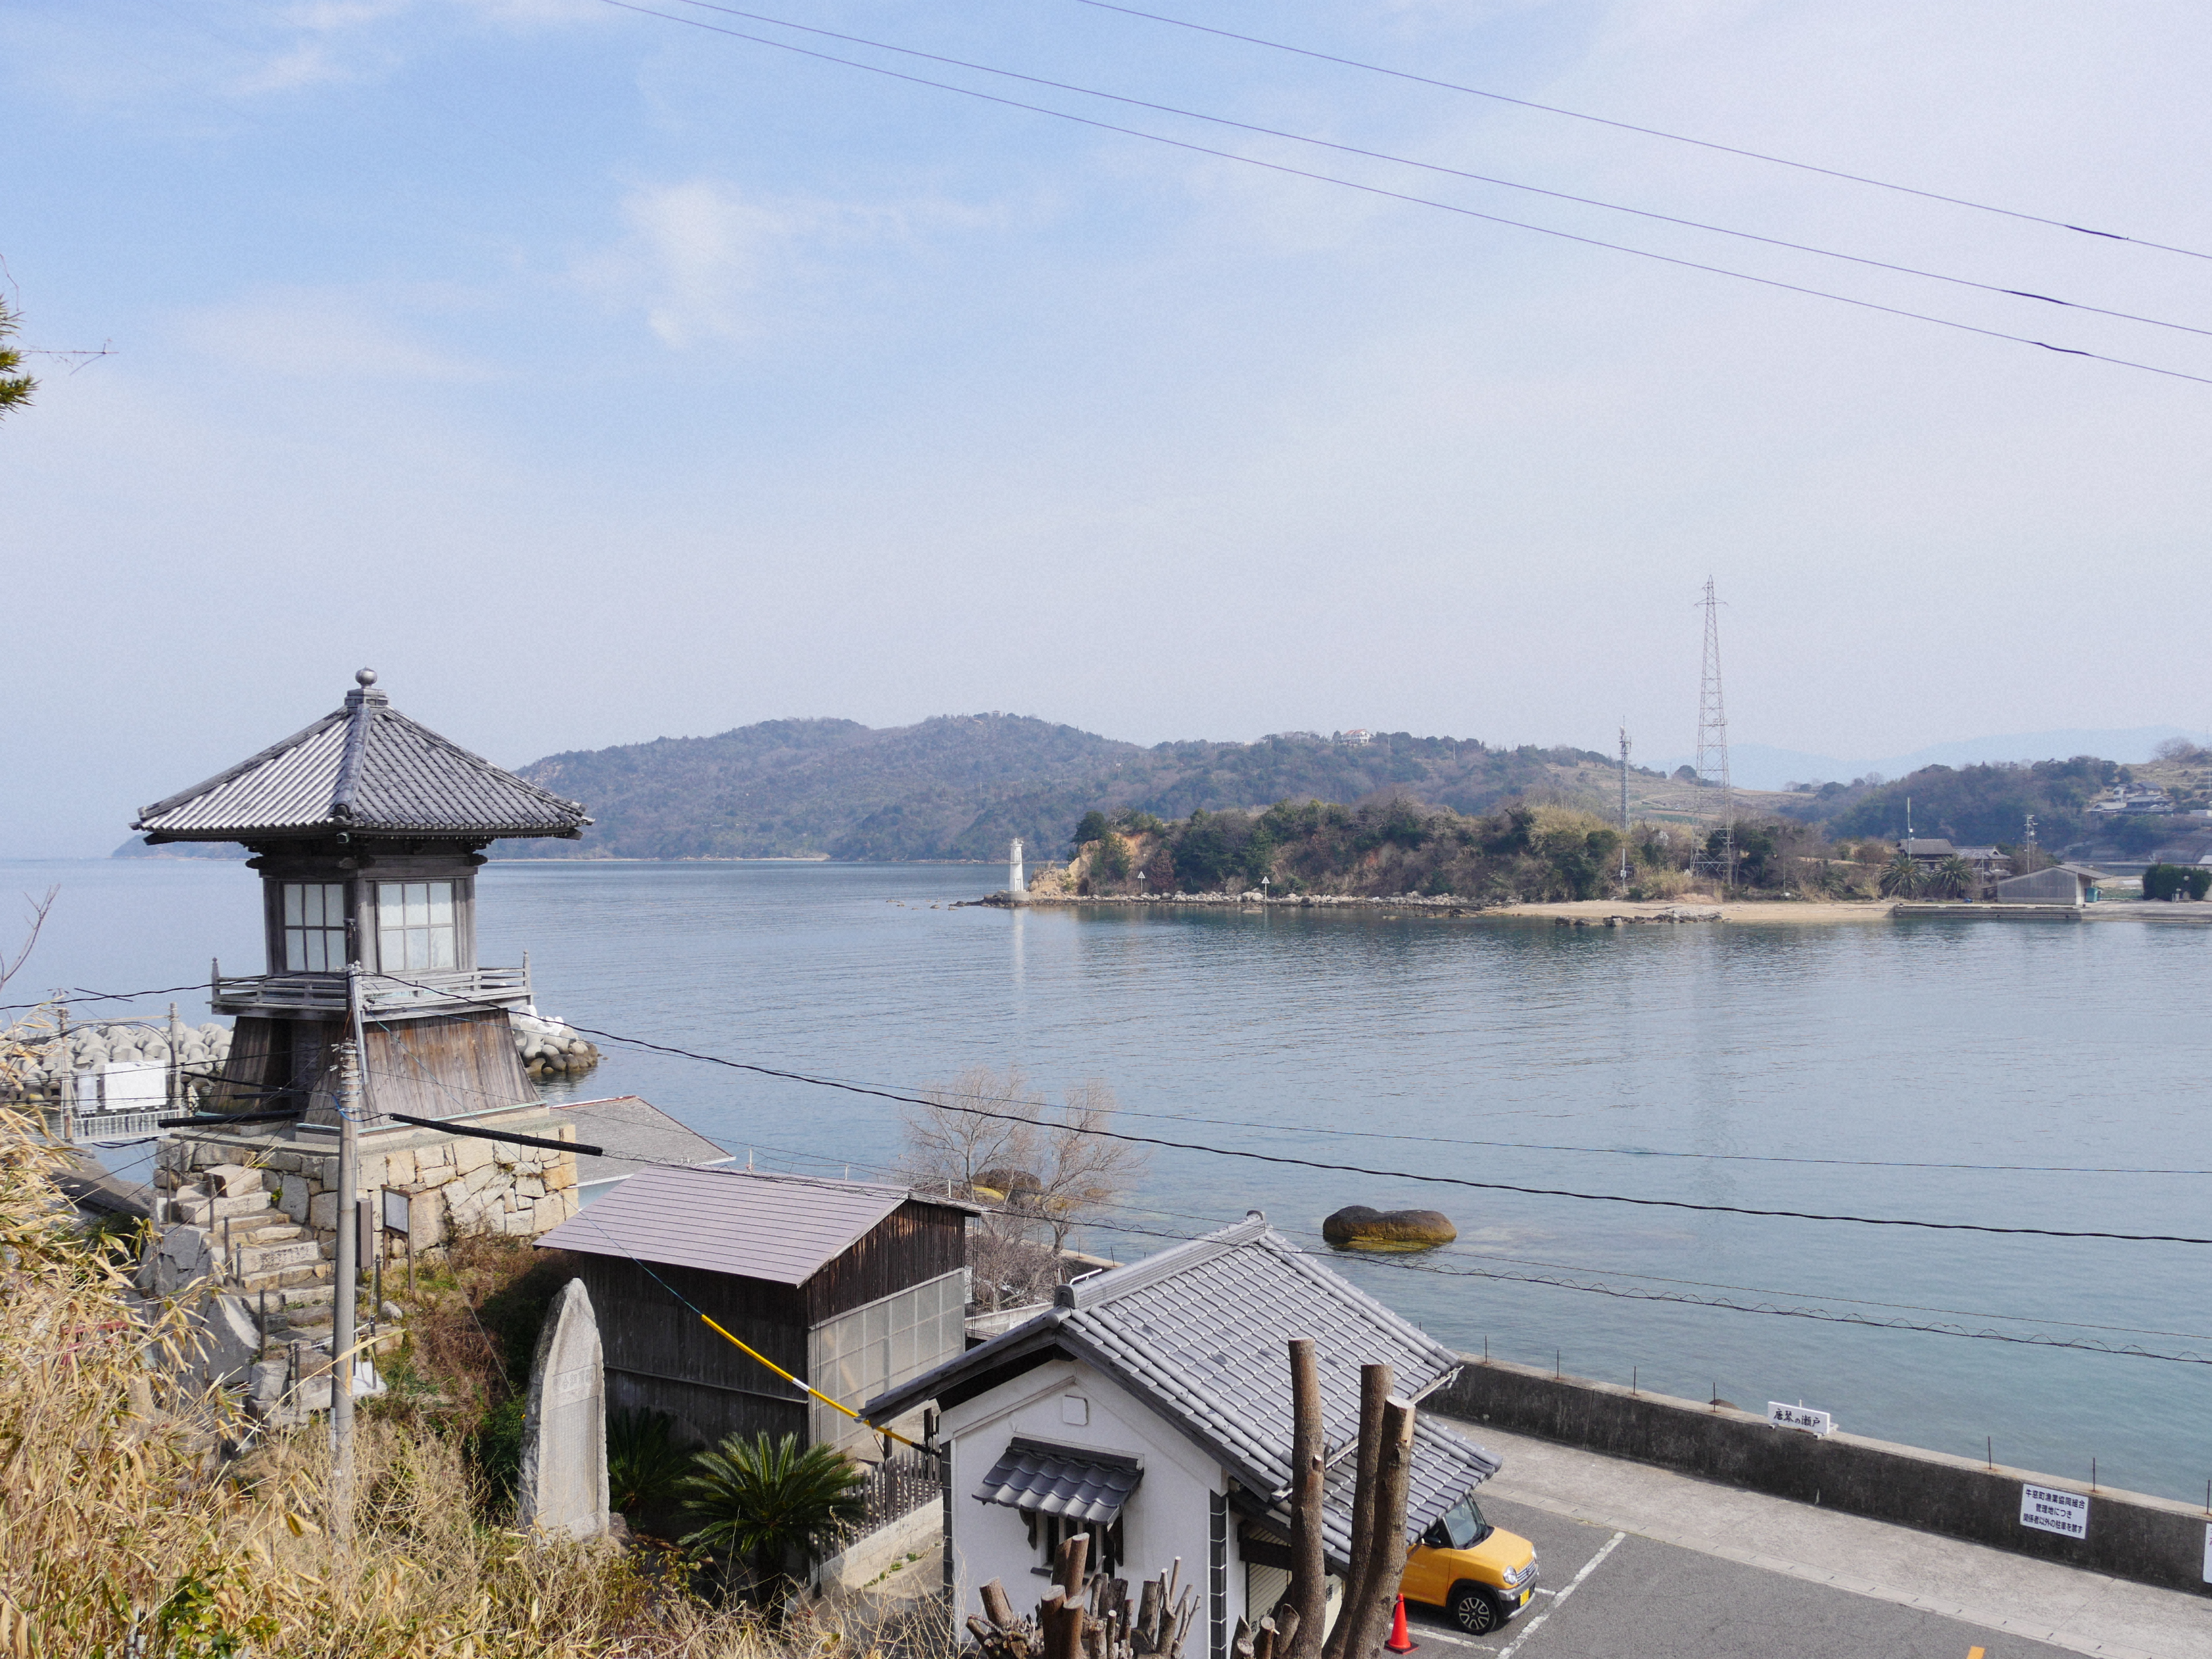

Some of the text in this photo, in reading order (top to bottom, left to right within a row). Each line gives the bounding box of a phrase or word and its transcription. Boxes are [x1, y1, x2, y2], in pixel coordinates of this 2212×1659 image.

[1773, 1407, 1821, 1427] 唐琴の瀬戸
[2025, 1488, 2085, 1509] 牛窓町漁業協同組合
[2035, 1503, 2072, 1519] 管理地につき
[2022, 1513, 2083, 1534] 関係者以外の駐車を禁ず
